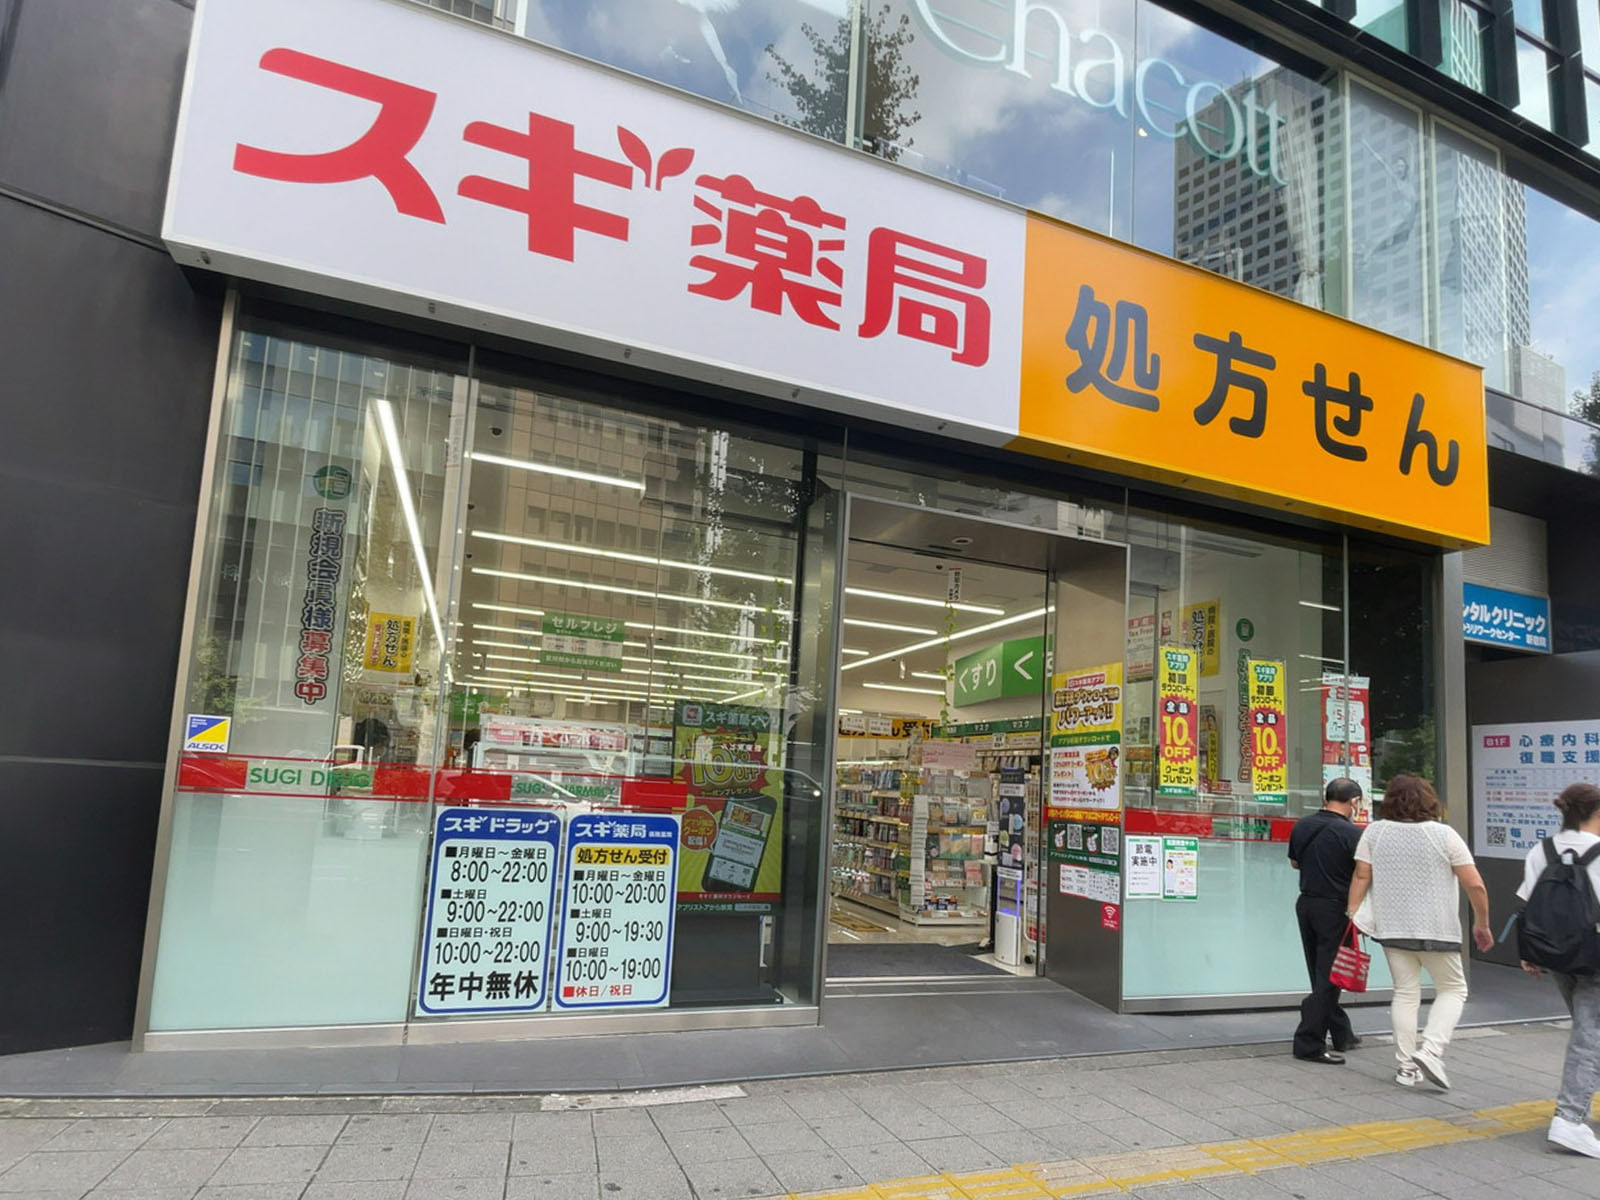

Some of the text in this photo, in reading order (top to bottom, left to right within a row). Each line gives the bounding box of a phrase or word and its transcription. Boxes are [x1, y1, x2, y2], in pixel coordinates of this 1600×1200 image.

[233, 47, 991, 368] スギ薬局
[1065, 284, 1460, 487] 処方せん
[552, 616, 617, 633] セルフレジ
[383, 619, 401, 667] 処方せん
[959, 659, 997, 693] くすり
[1165, 700, 1190, 714] 全品
[1012, 719, 1030, 729] マスク
[1255, 712, 1278, 724] 全品
[187, 742, 225, 751] ALSOK
[1519, 733, 1599, 748] 心療内科
[1164, 746, 1191, 758] OFF
[1255, 756, 1280, 767] OFF
[250, 767, 301, 784] SUGI
[1165, 766, 1192, 775] クーポン
[1163, 775, 1194, 784] プレゼント
[1256, 774, 1282, 783] クーポン
[1255, 783, 1284, 792] プレゼント
[443, 815, 557, 834] スギドラッグ
[574, 820, 647, 838] スギ薬局
[1511, 840, 1539, 849] Tel.0
[577, 848, 667, 864] 処方せん受付
[452, 888, 487, 899] 土曜日
[581, 908, 612, 919] 土曜日
[578, 947, 609, 957] 日曜日
[428, 969, 539, 1001] 年中無休
